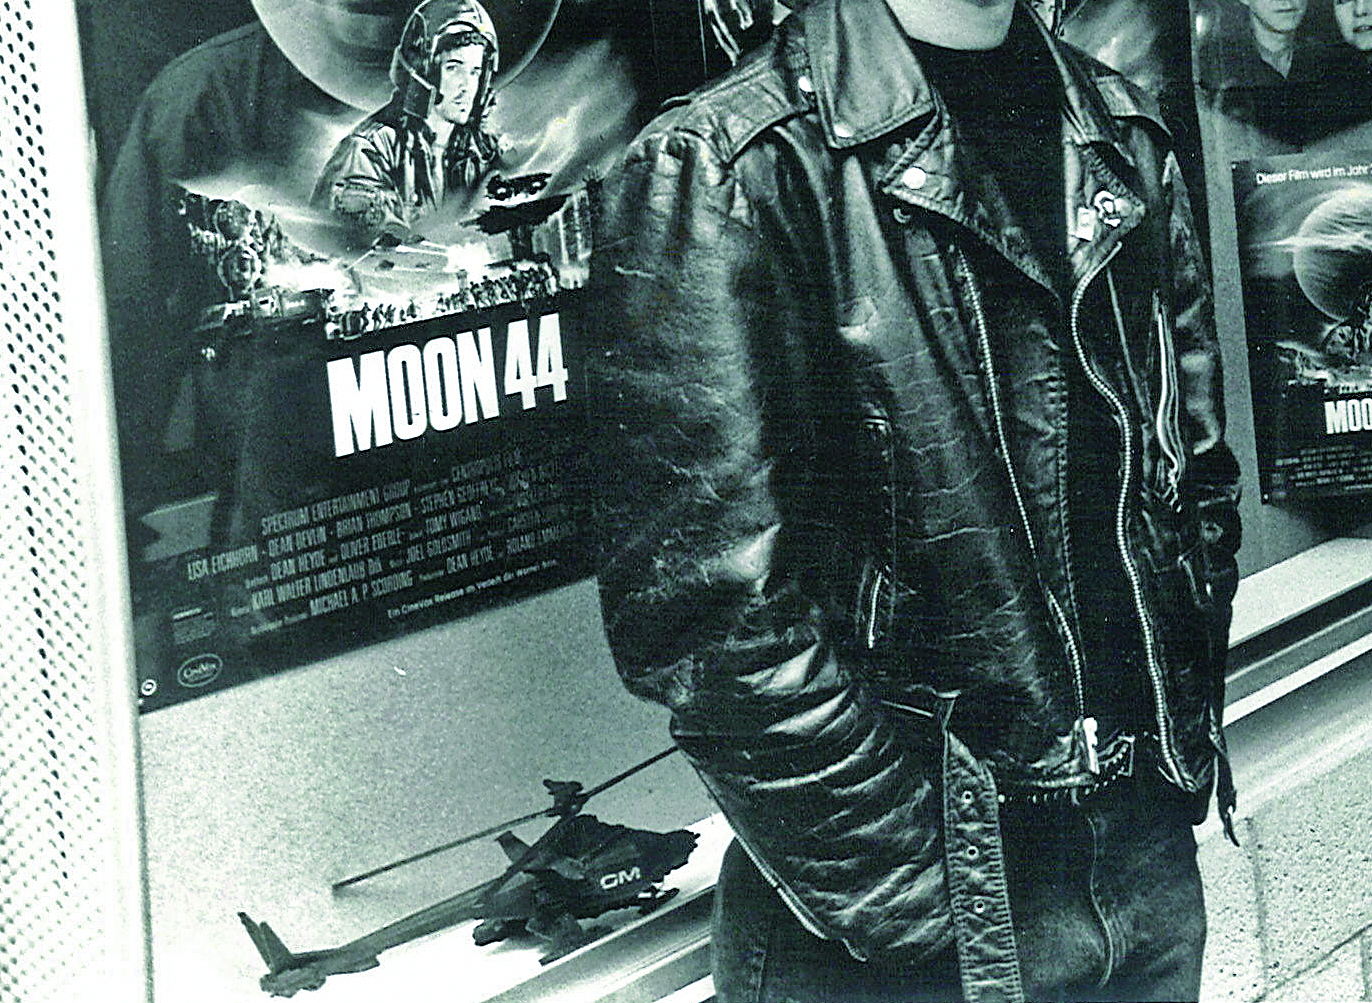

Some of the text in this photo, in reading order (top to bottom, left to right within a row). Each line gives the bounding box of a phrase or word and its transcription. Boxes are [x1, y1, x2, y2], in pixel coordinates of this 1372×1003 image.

[1256, 172, 1286, 185] Dieser
[1289, 170, 1309, 181] Film
[1311, 168, 1331, 179] wird
[1333, 167, 1345, 177] im
[1347, 164, 1368, 176] Jahr
[326, 312, 569, 458] MOON 44
[268, 535, 293, 559] DEAN
[270, 559, 297, 583] DEAN
[251, 589, 275, 613] KARL
